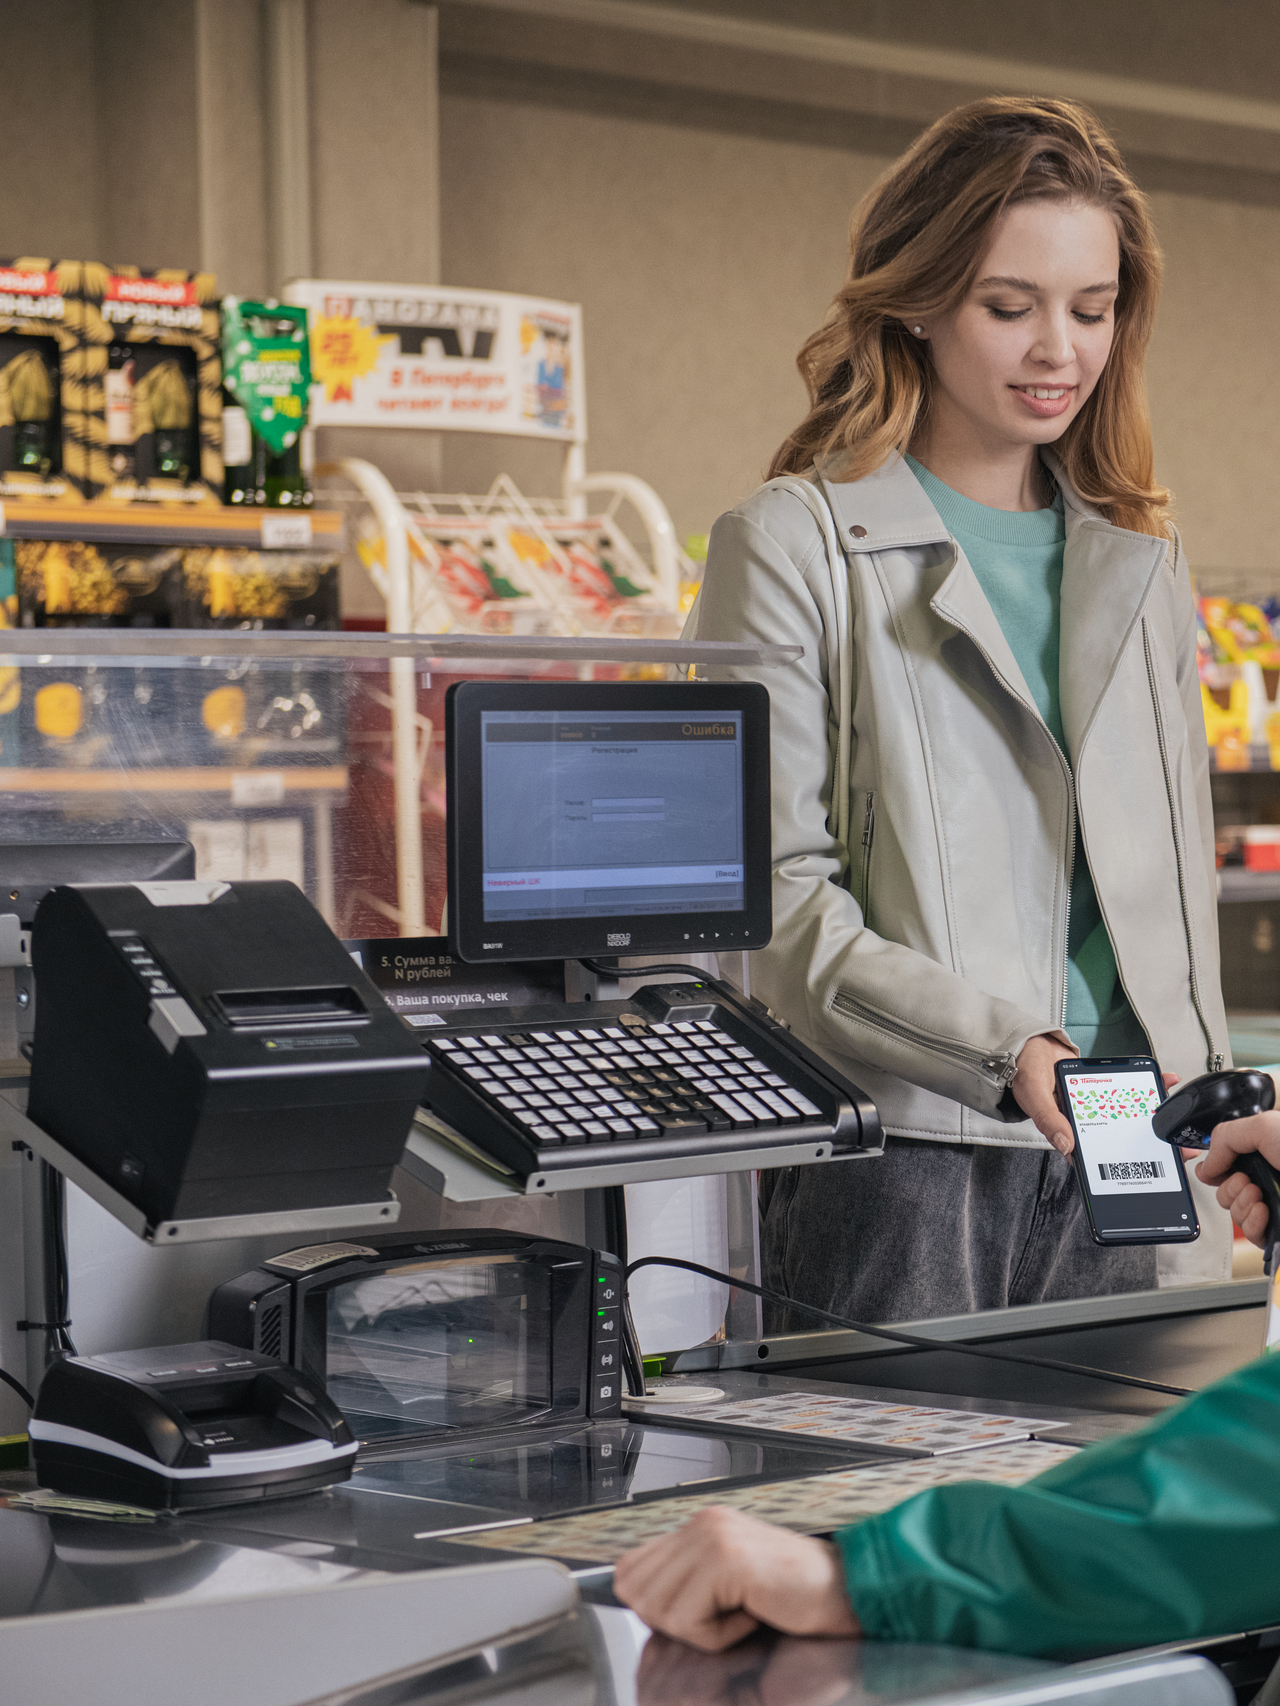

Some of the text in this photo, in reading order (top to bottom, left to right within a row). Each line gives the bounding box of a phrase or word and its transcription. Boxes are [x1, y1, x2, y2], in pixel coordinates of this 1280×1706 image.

[681, 723, 735, 736] Ошибка
[487, 879, 526, 888] Неверный
[381, 956, 457, 969] 5. Сумма ва
[395, 966, 452, 982] N рублей
[396, 994, 430, 1006] Ваша
[432, 993, 486, 1006] покупка,
[487, 992, 509, 1001] чек
[429, 1241, 471, 1253] ZEBRA
